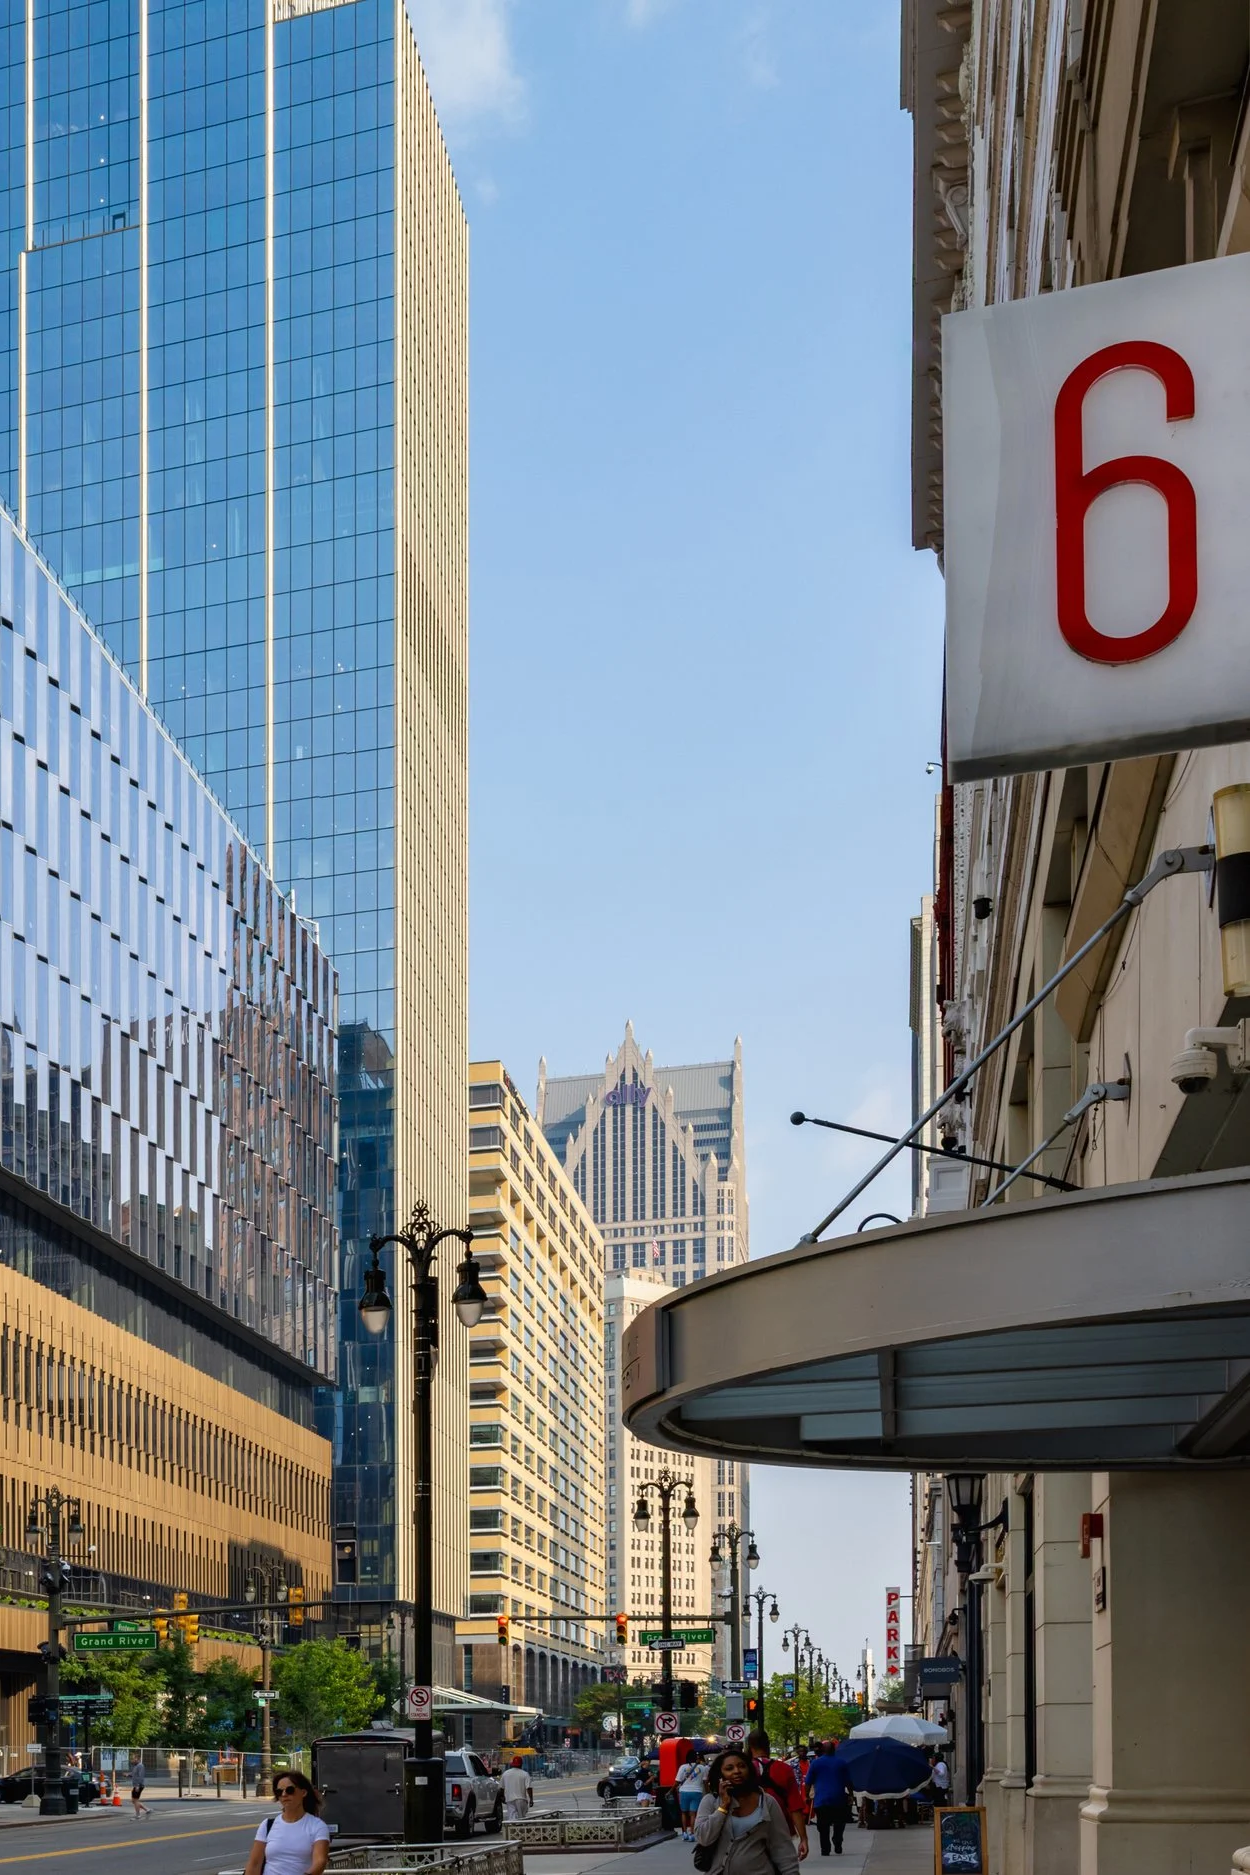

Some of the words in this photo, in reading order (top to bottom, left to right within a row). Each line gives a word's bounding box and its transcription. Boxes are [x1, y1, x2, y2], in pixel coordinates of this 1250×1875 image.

[1054, 340, 1198, 665] 6
[605, 1083, 652, 1108] ally
[81, 1638, 113, 1646] Grand
[119, 1637, 149, 1645] River
[887, 1592, 899, 1660] PARK
